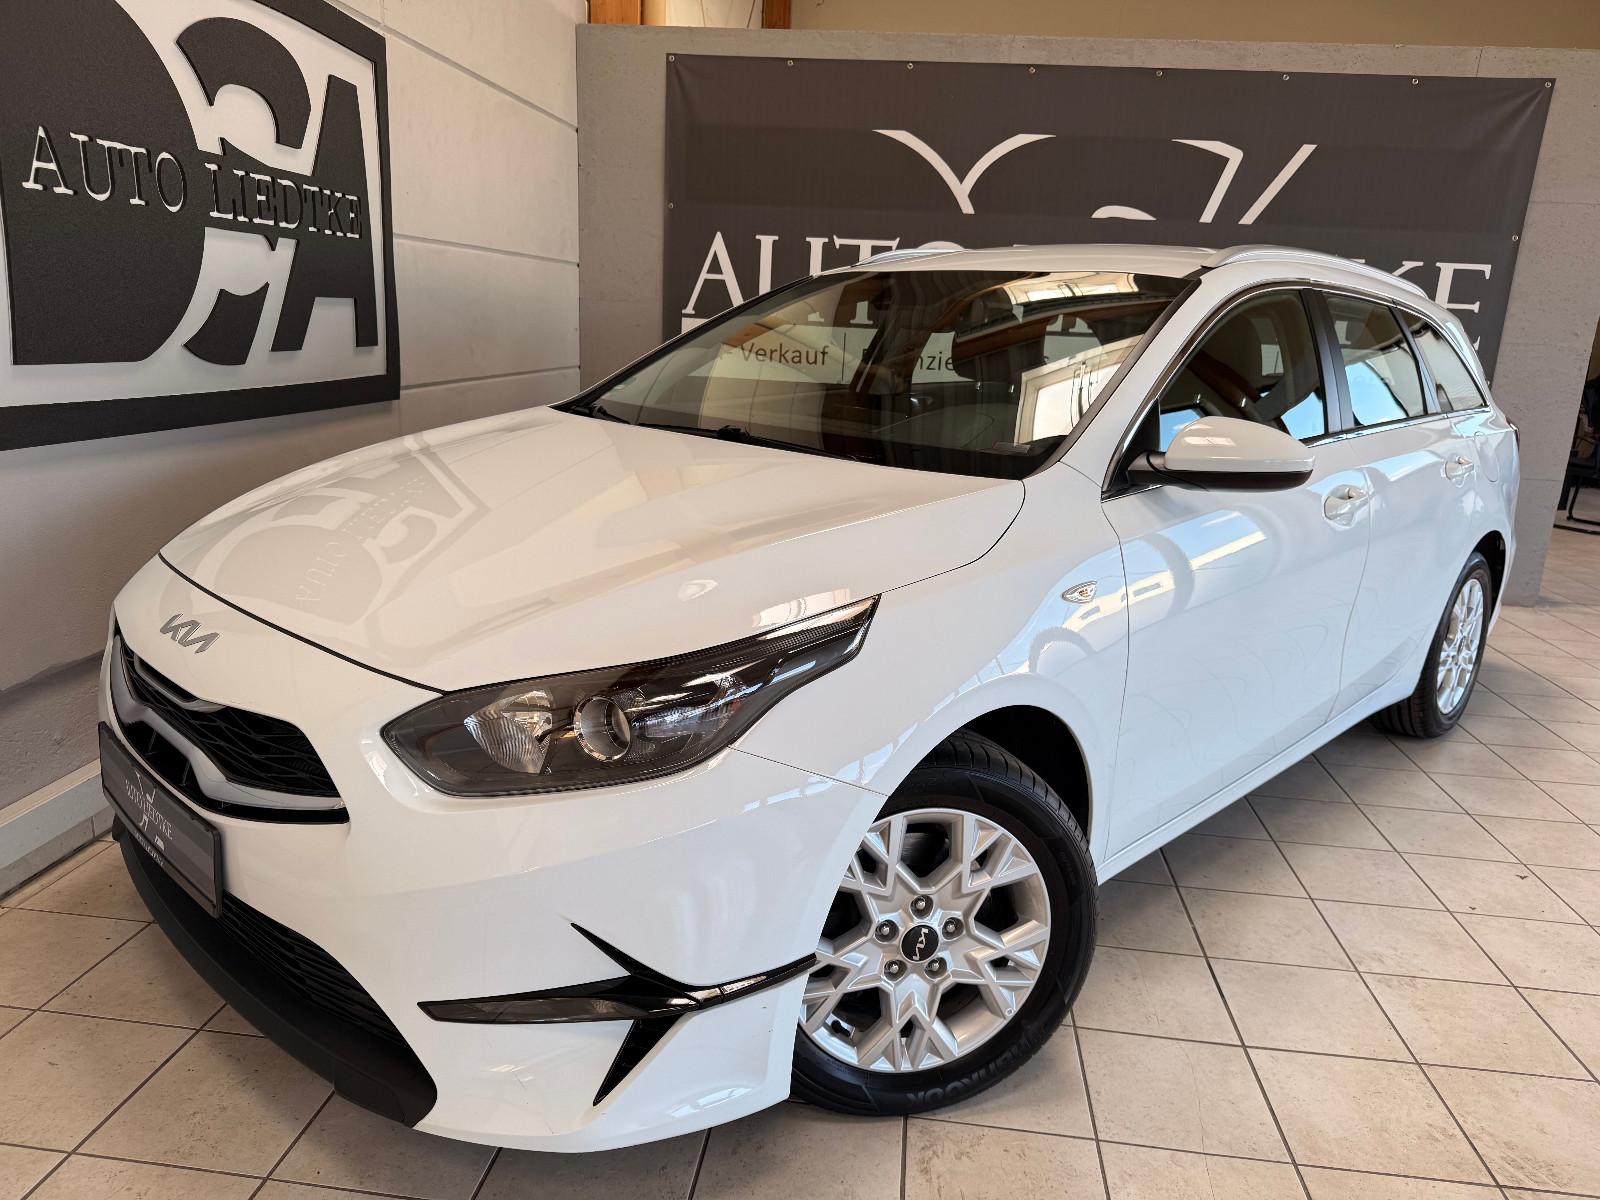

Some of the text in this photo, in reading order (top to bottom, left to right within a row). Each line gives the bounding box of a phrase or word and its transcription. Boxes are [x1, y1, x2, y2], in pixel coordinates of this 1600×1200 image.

[21, 125, 361, 239] AUTO LIEDTKE
[682, 231, 966, 324] AUT
[739, 342, 829, 366] Verkauf
